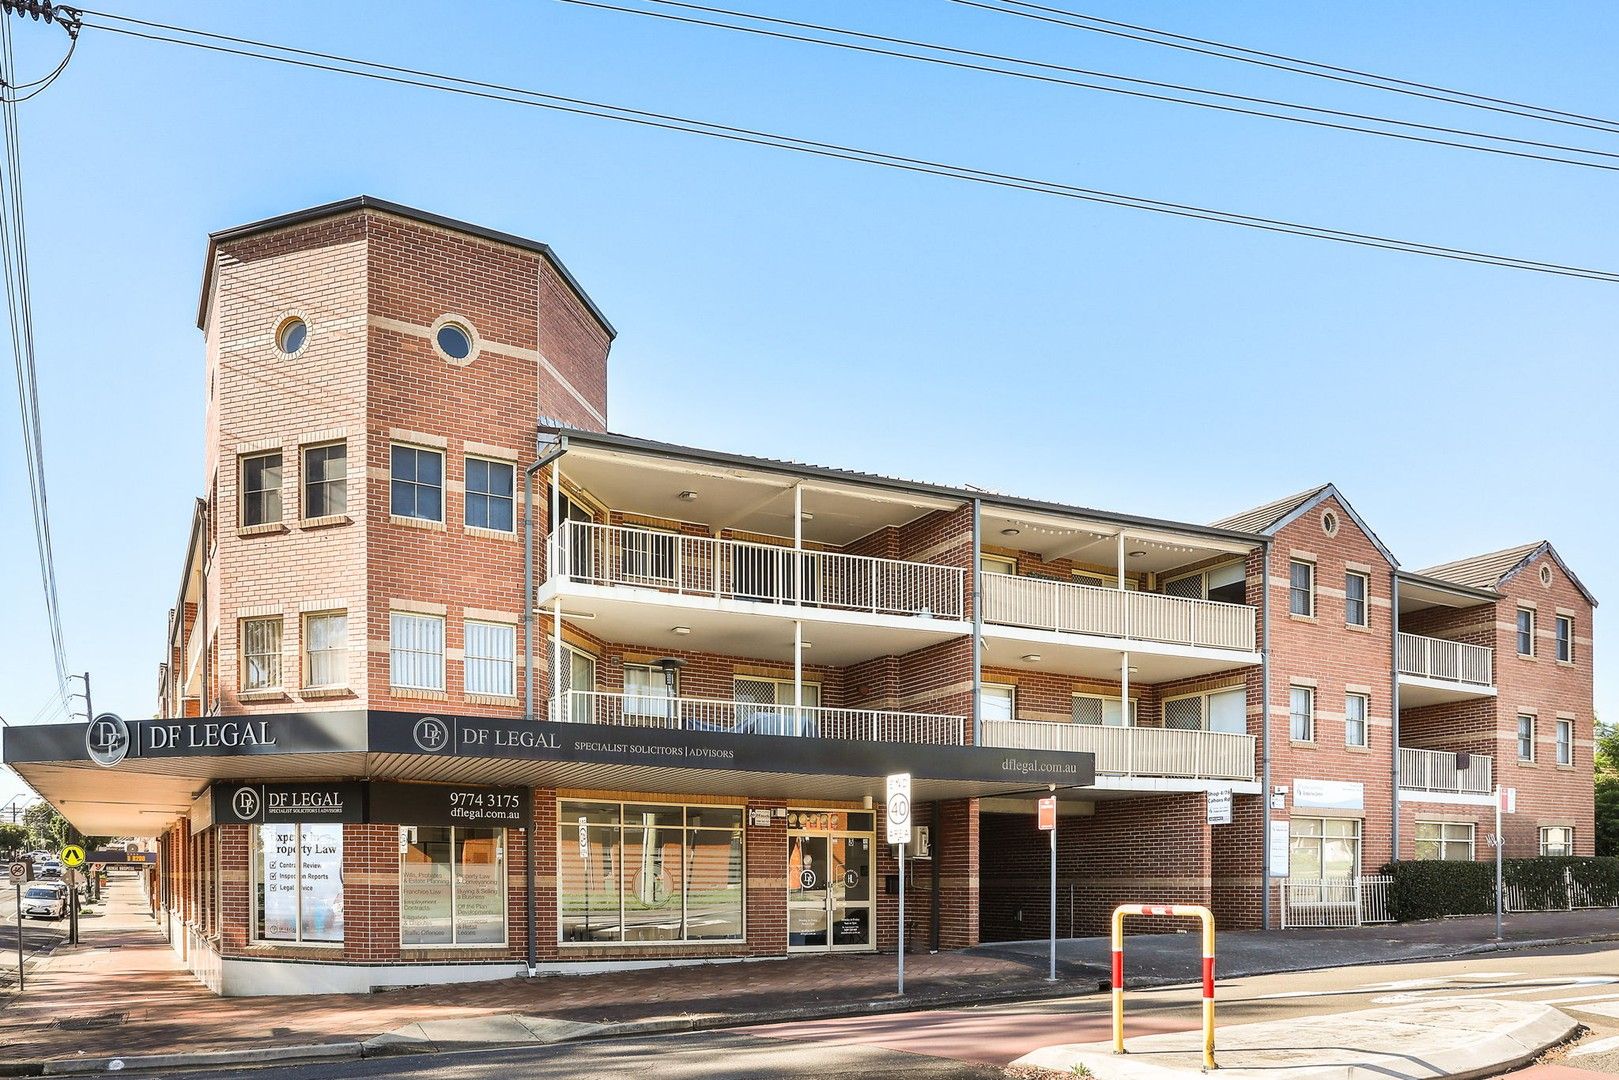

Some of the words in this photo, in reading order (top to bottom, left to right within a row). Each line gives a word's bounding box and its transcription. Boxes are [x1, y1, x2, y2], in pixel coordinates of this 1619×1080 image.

[149, 725, 182, 749] DF
[188, 721, 277, 748] LEGAL
[462, 728, 490, 744] DF
[495, 730, 562, 749] LEGAL
[574, 741, 629, 753] SPECIALIST
[629, 744, 683, 756] SOLICITORS
[688, 748, 735, 758] ADVISORS
[1001, 758, 1077, 774] dflegal.com.au
[268, 793, 289, 806] DF
[291, 792, 344, 806] LEGAL
[450, 792, 483, 806] 9774
[487, 794, 519, 808] 3175
[450, 807, 520, 819] dflegal.com.au
[891, 801, 907, 816] 40
[315, 844, 337, 854] Law
[308, 872, 329, 880] Reports
